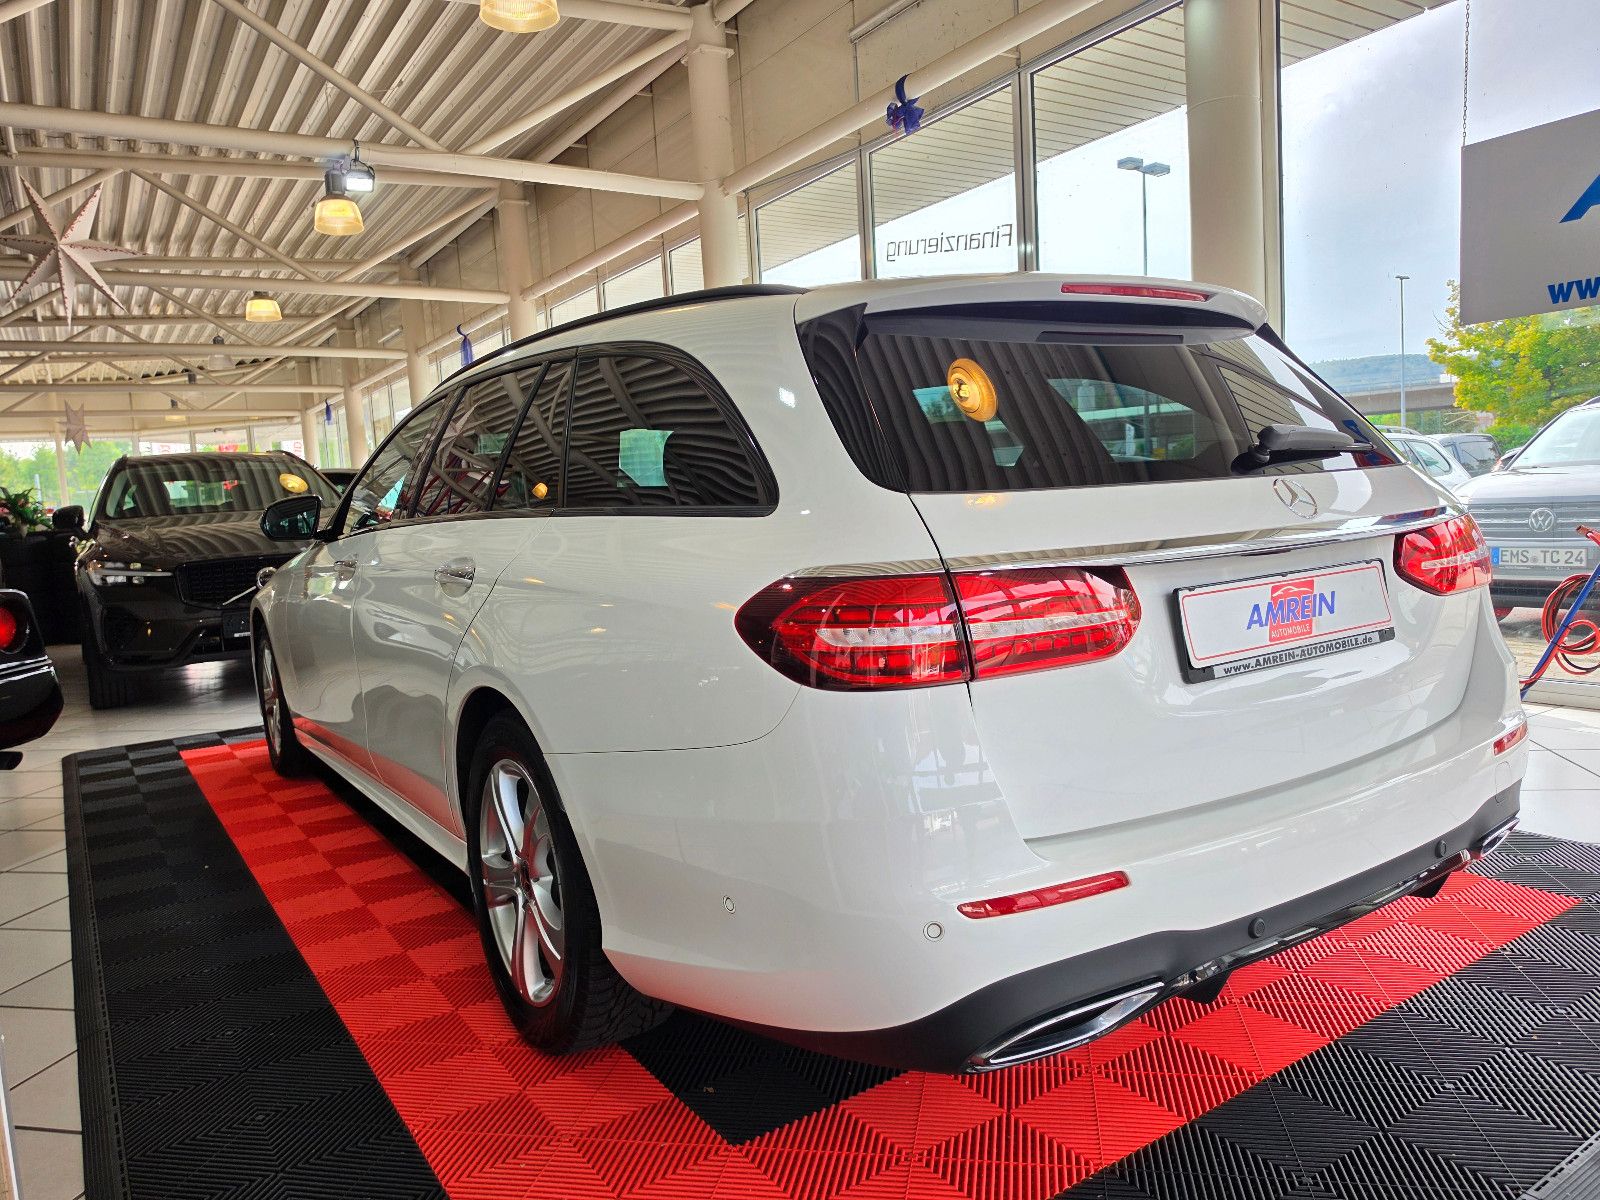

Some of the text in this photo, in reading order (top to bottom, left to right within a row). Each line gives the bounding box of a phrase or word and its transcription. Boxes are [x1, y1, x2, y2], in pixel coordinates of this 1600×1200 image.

[1500, 549, 1584, 565] EMS TC 24
[1246, 590, 1336, 630] AMREIN
[1271, 623, 1311, 639] AUTOMOBILE
[1223, 636, 1373, 675] www.AMREIN-AUTOMOBILE.de
